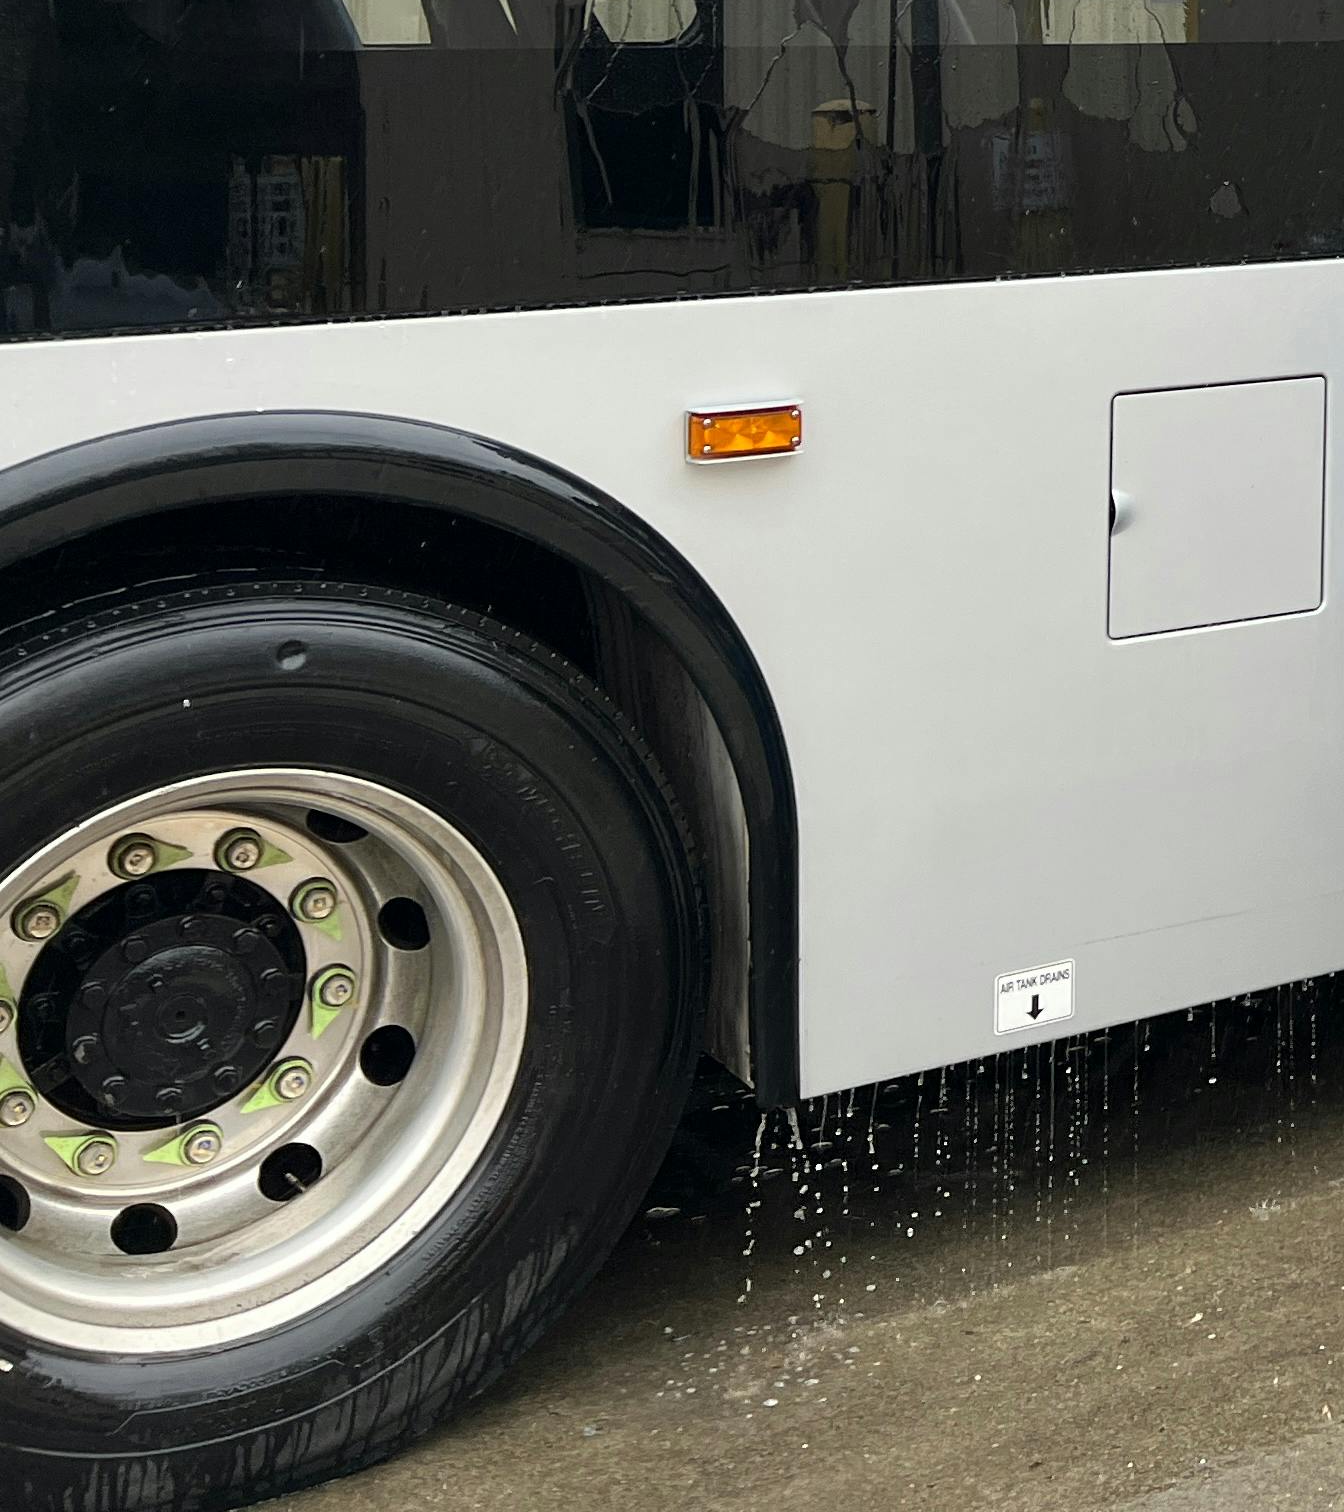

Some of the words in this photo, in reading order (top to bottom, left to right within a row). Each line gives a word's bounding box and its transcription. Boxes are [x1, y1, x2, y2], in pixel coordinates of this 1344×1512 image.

[1000, 981, 1014, 994] AIR
[1016, 975, 1038, 991] TANK
[1039, 968, 1070, 986] DRAINS
